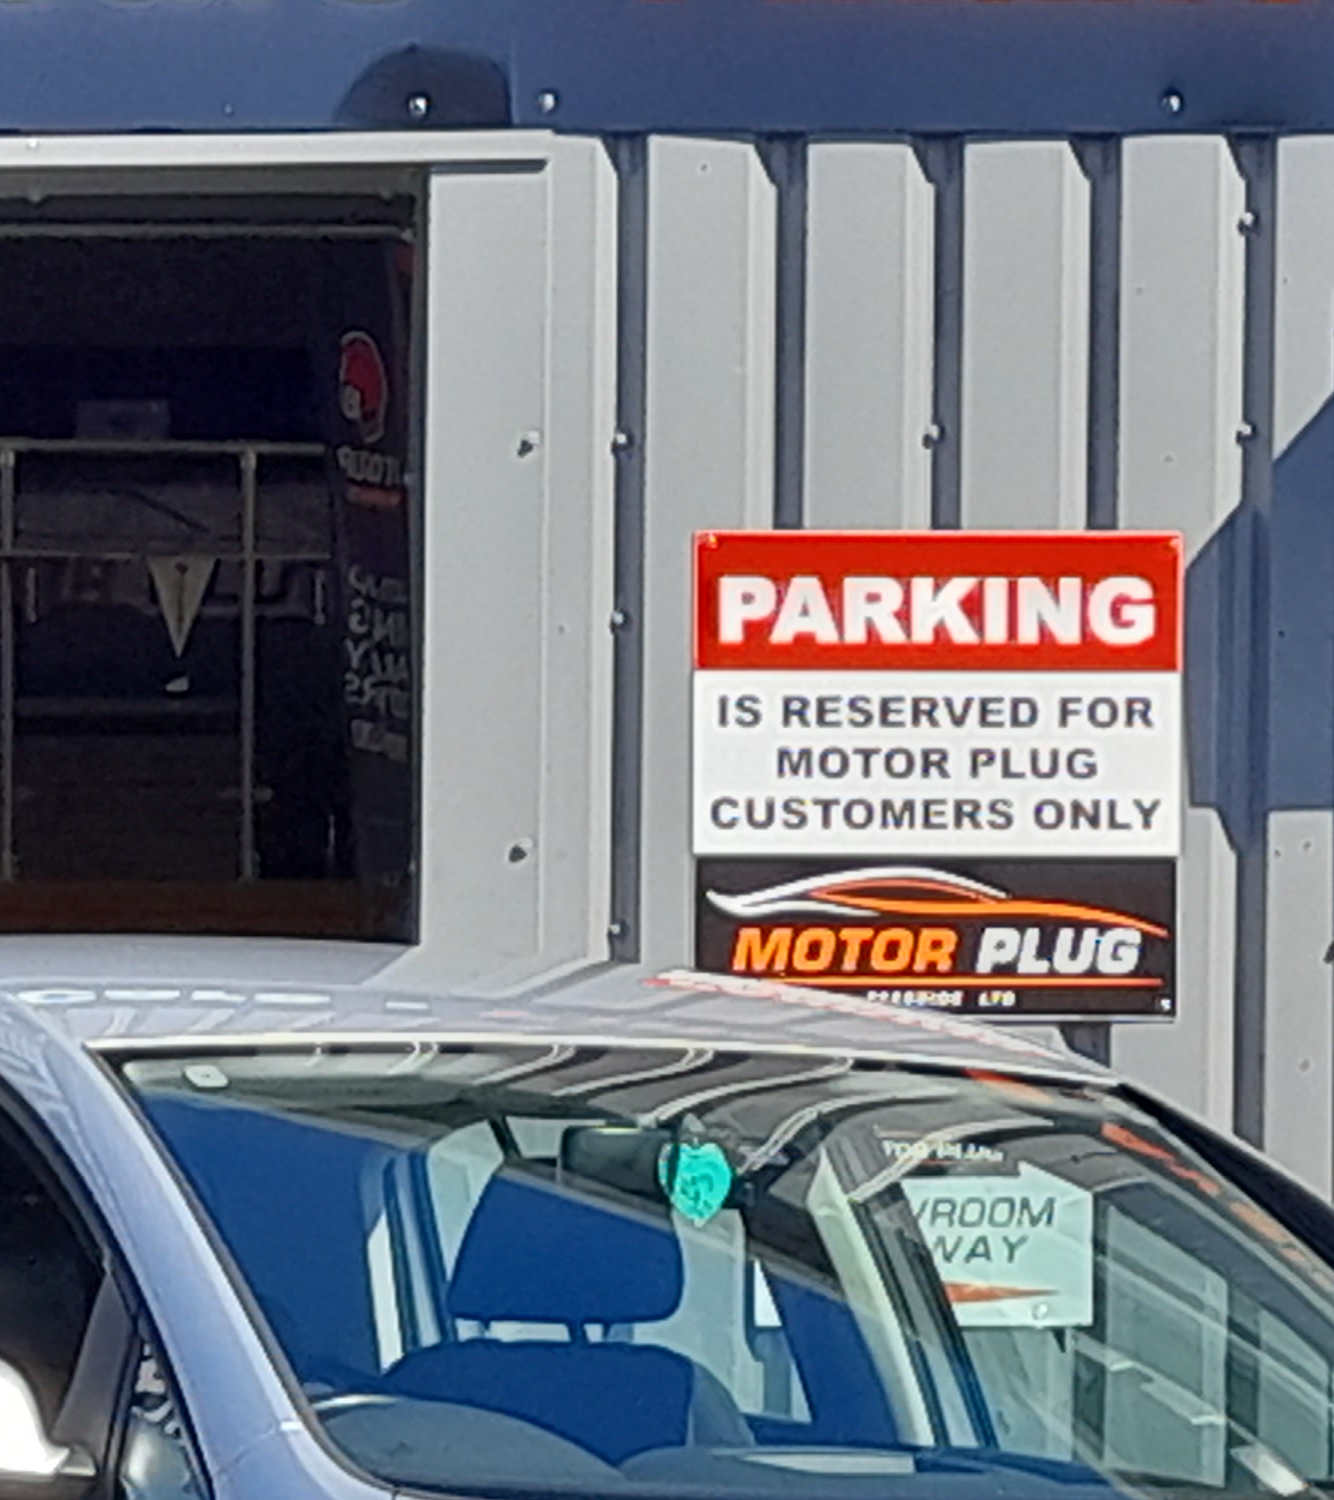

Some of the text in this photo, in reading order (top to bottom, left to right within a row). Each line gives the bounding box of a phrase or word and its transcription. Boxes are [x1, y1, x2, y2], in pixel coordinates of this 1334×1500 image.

[717, 575, 1155, 645] PARKING
[718, 696, 1153, 728] IS RESERVED FOR
[777, 747, 1098, 779] MOTOR PLUG
[711, 797, 1161, 830] CUSTOMERS ONLY
[732, 927, 1141, 974] MOTOR PLUG
